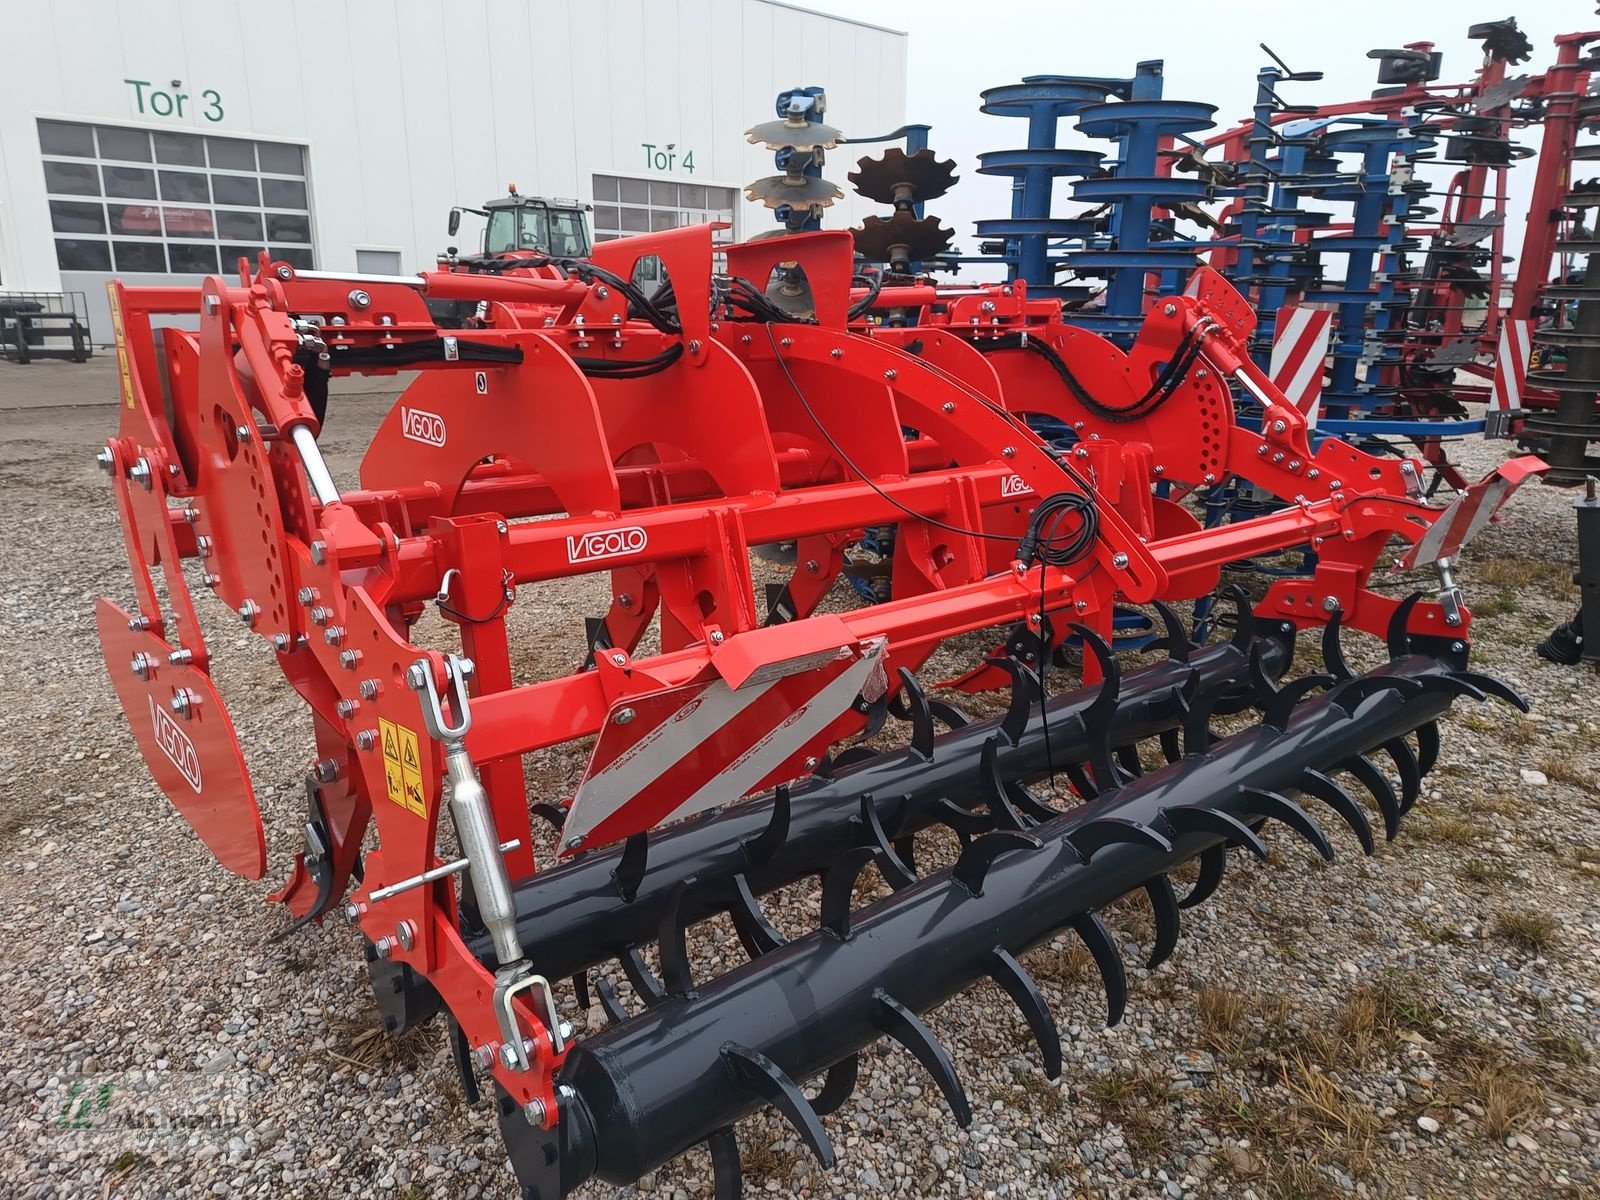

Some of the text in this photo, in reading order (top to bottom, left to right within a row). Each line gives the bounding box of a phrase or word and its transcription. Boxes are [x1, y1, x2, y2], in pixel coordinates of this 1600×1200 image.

[124, 79, 224, 122] Tor 3
[642, 144, 695, 174] Tor 4
[401, 406, 447, 448] VIGOLO
[566, 526, 648, 564] VIGOLO
[147, 692, 202, 794] VIGOLO
